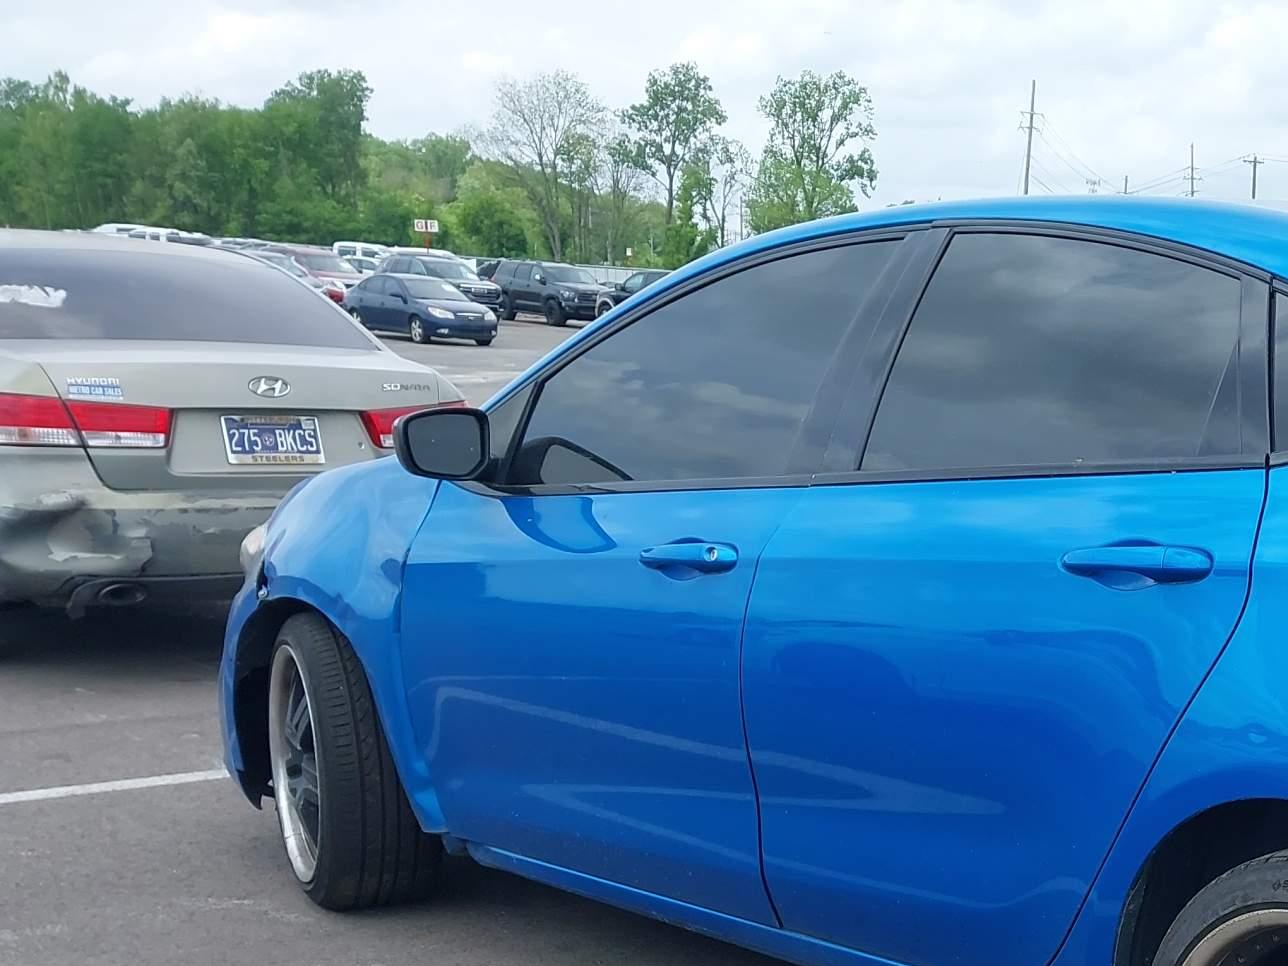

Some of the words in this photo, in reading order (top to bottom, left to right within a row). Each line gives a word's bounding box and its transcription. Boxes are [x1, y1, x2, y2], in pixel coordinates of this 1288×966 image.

[66, 377, 119, 385] HYUNDAI
[382, 383, 431, 391] SONATA
[91, 387, 103, 395] CAR
[104, 387, 122, 396] SALES
[230, 429, 262, 451] 275
[275, 429, 317, 451] BKCS
[251, 455, 304, 463] STEELERS
